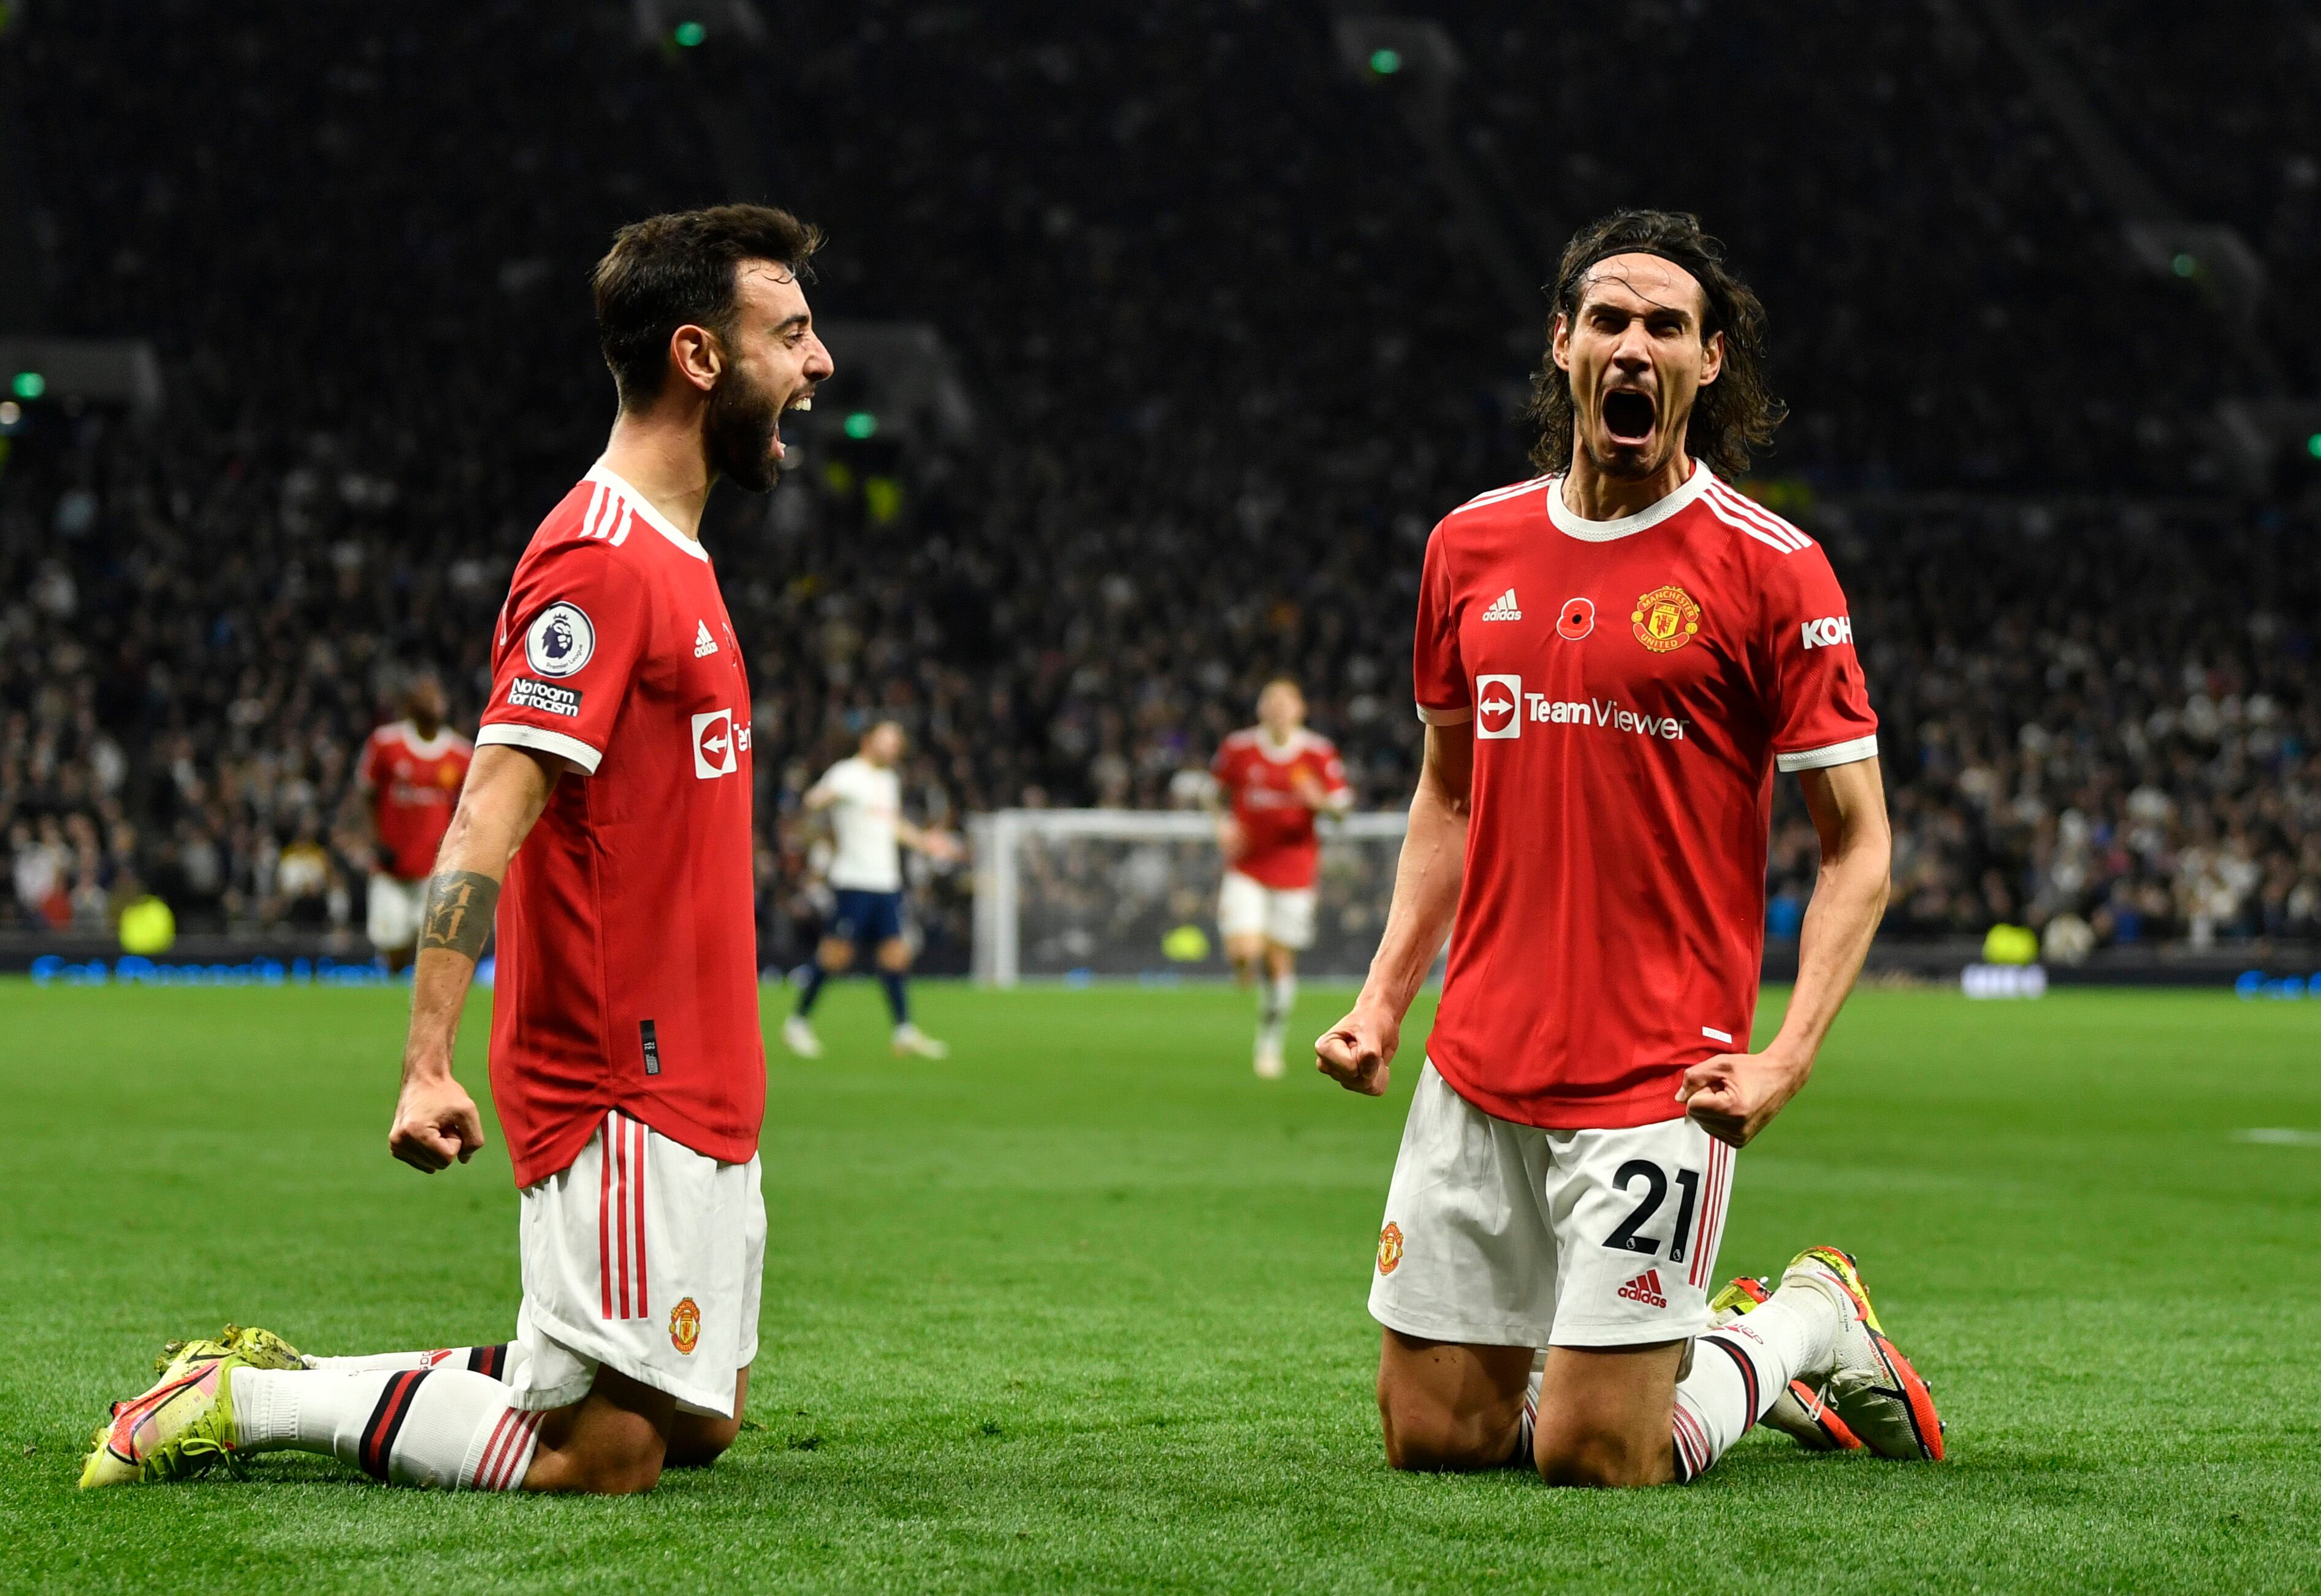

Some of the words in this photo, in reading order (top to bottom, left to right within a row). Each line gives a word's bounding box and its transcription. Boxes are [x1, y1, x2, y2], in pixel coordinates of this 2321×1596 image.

[1482, 609, 1522, 621] adidas
[1642, 590, 1694, 618] MANCHESTER
[1640, 633, 1678, 648] UNITED
[1801, 617, 1854, 650] KOH
[568, 644, 583, 664] League
[507, 690, 530, 705] for
[528, 695, 579, 717] racism
[511, 677, 533, 694] No
[532, 682, 574, 704] room
[1523, 693, 1690, 740] TeamViewer
[1601, 1159, 1699, 1264] 21
[1617, 1287, 1667, 1309] adidas
